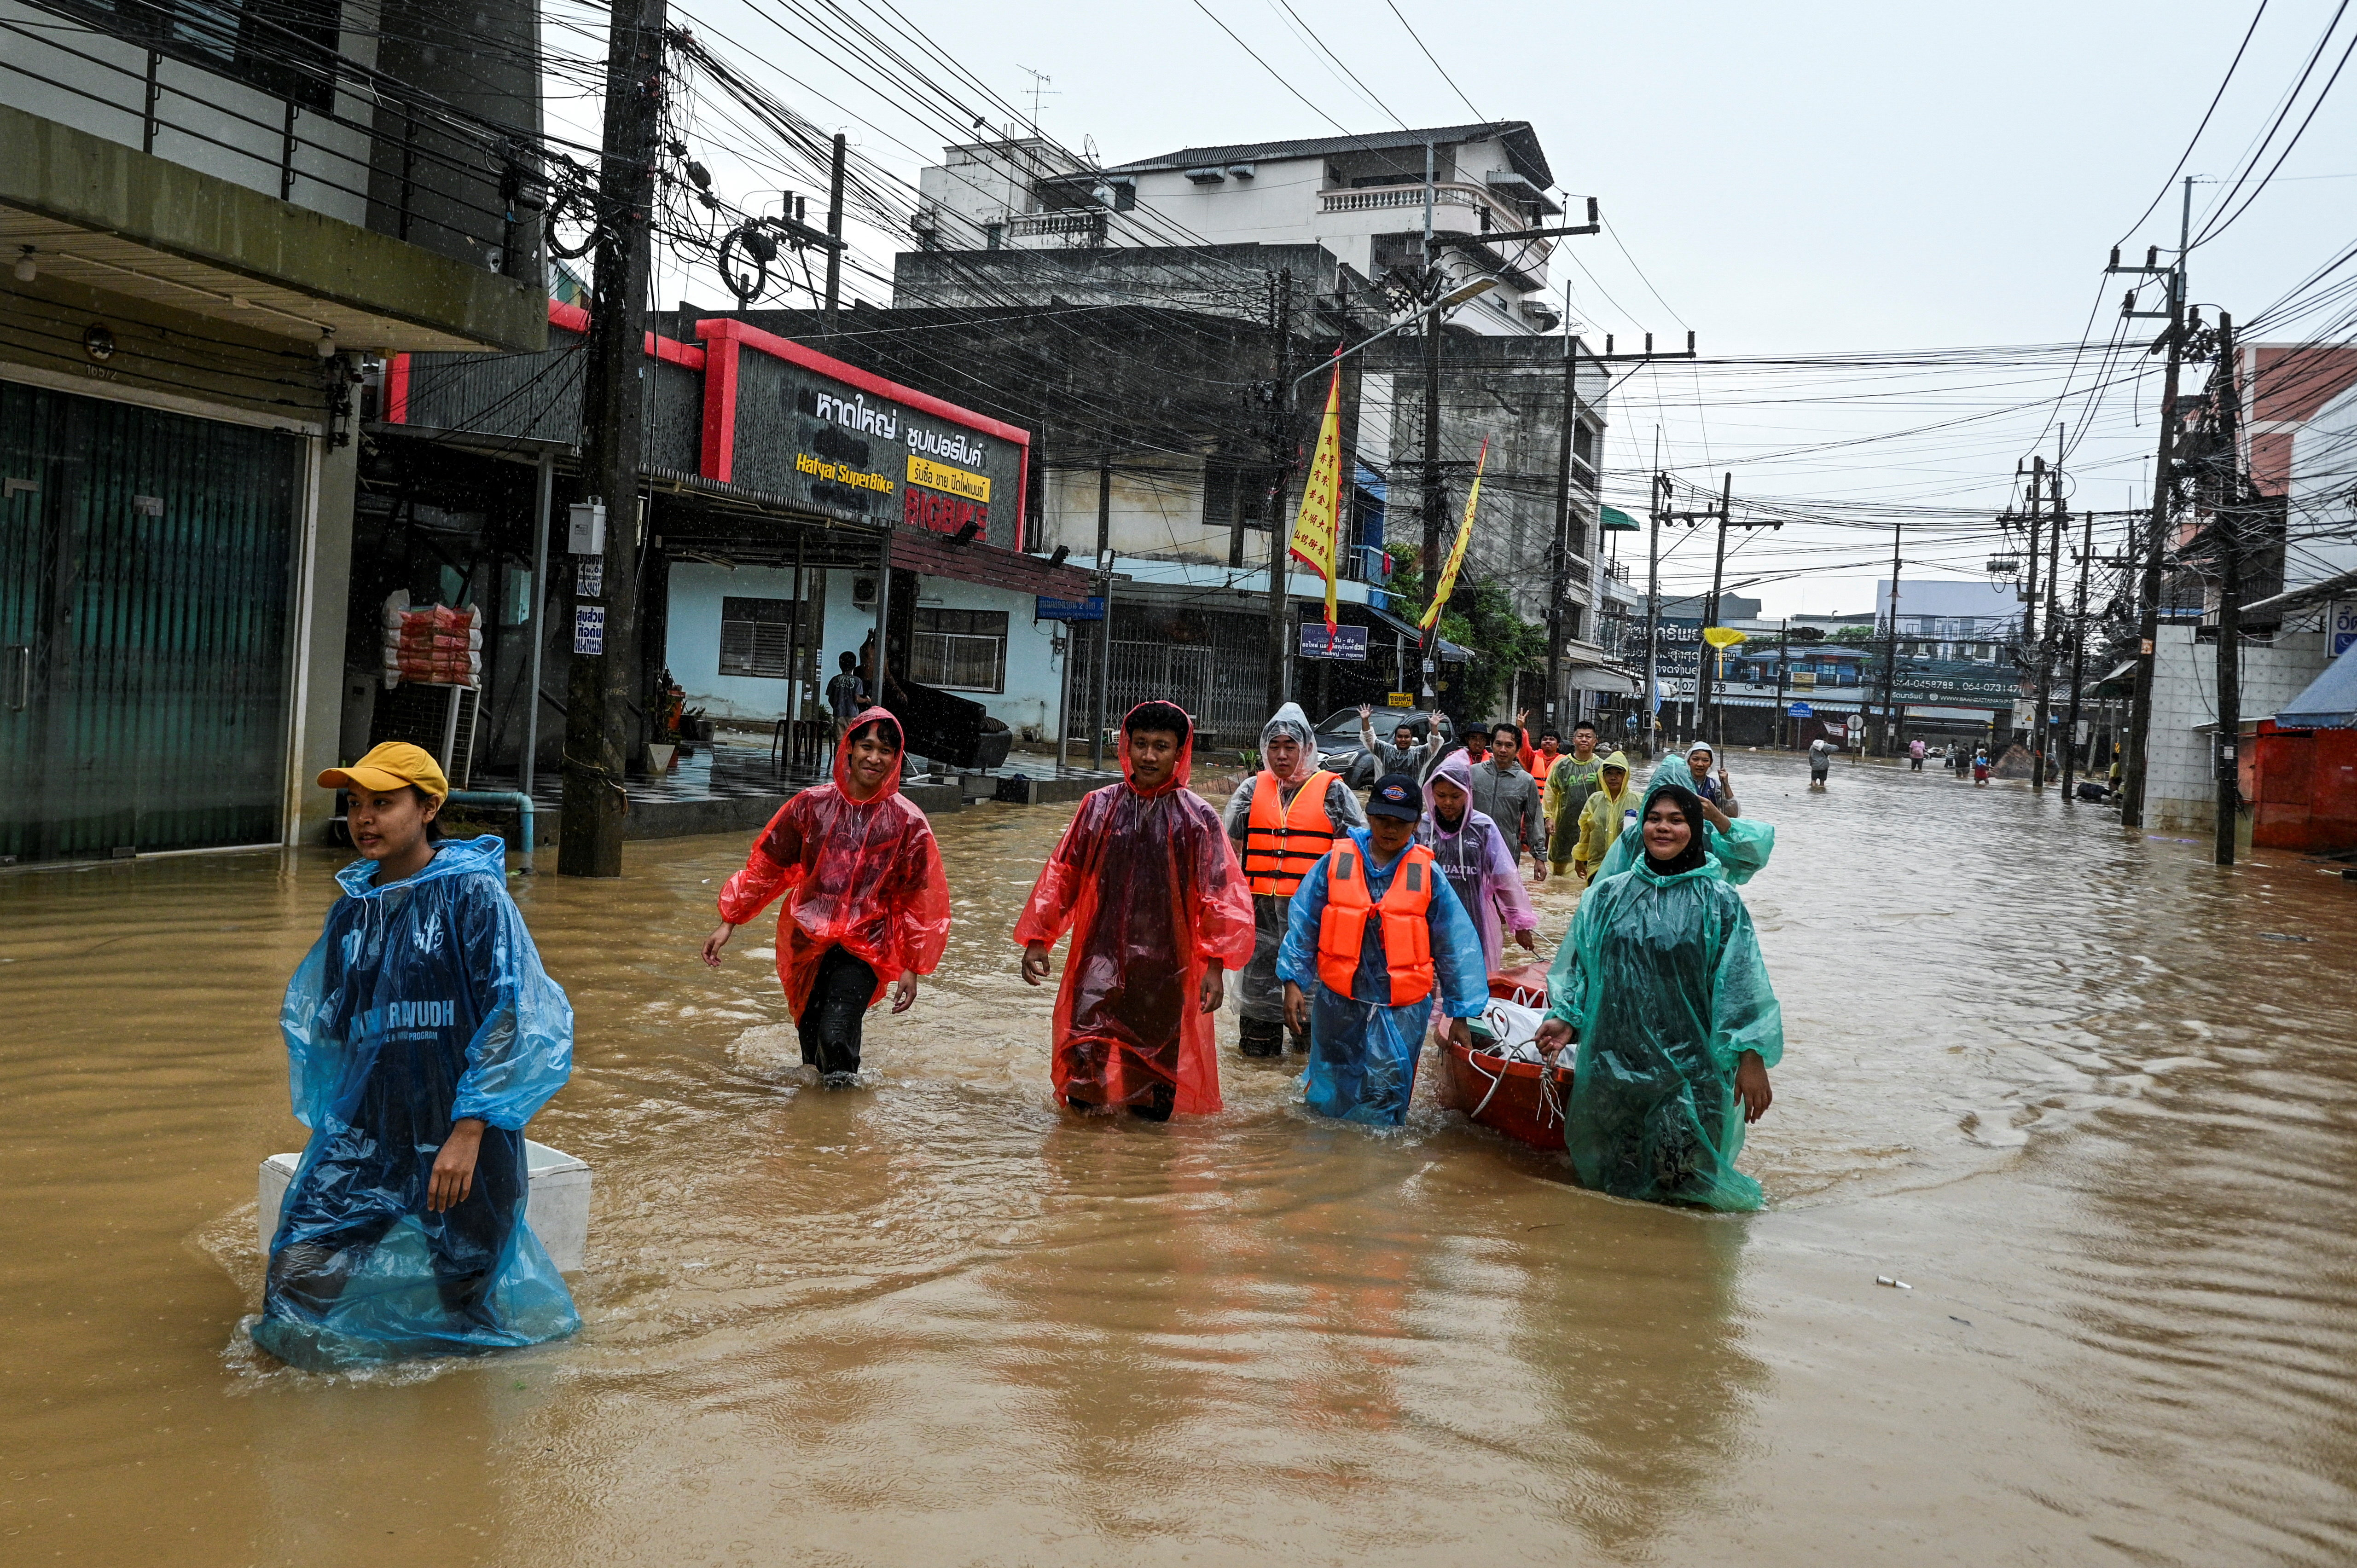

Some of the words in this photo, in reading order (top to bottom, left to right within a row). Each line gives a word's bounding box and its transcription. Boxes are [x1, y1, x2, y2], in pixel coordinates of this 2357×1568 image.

[816, 393, 897, 440] หาดใหญ่
[796, 453, 837, 481] Hatyai
[837, 464, 894, 494] SuperBike
[914, 462, 933, 484] รับซื้อ
[936, 474, 948, 488] ขาย
[904, 487, 988, 541] BIGBIKE
[576, 607, 604, 625] สูบส้วม
[578, 624, 602, 638] ท่อตัน
[1893, 679, 1954, 689] 064-0458788
[408, 1031, 438, 1041] PROGRAM
